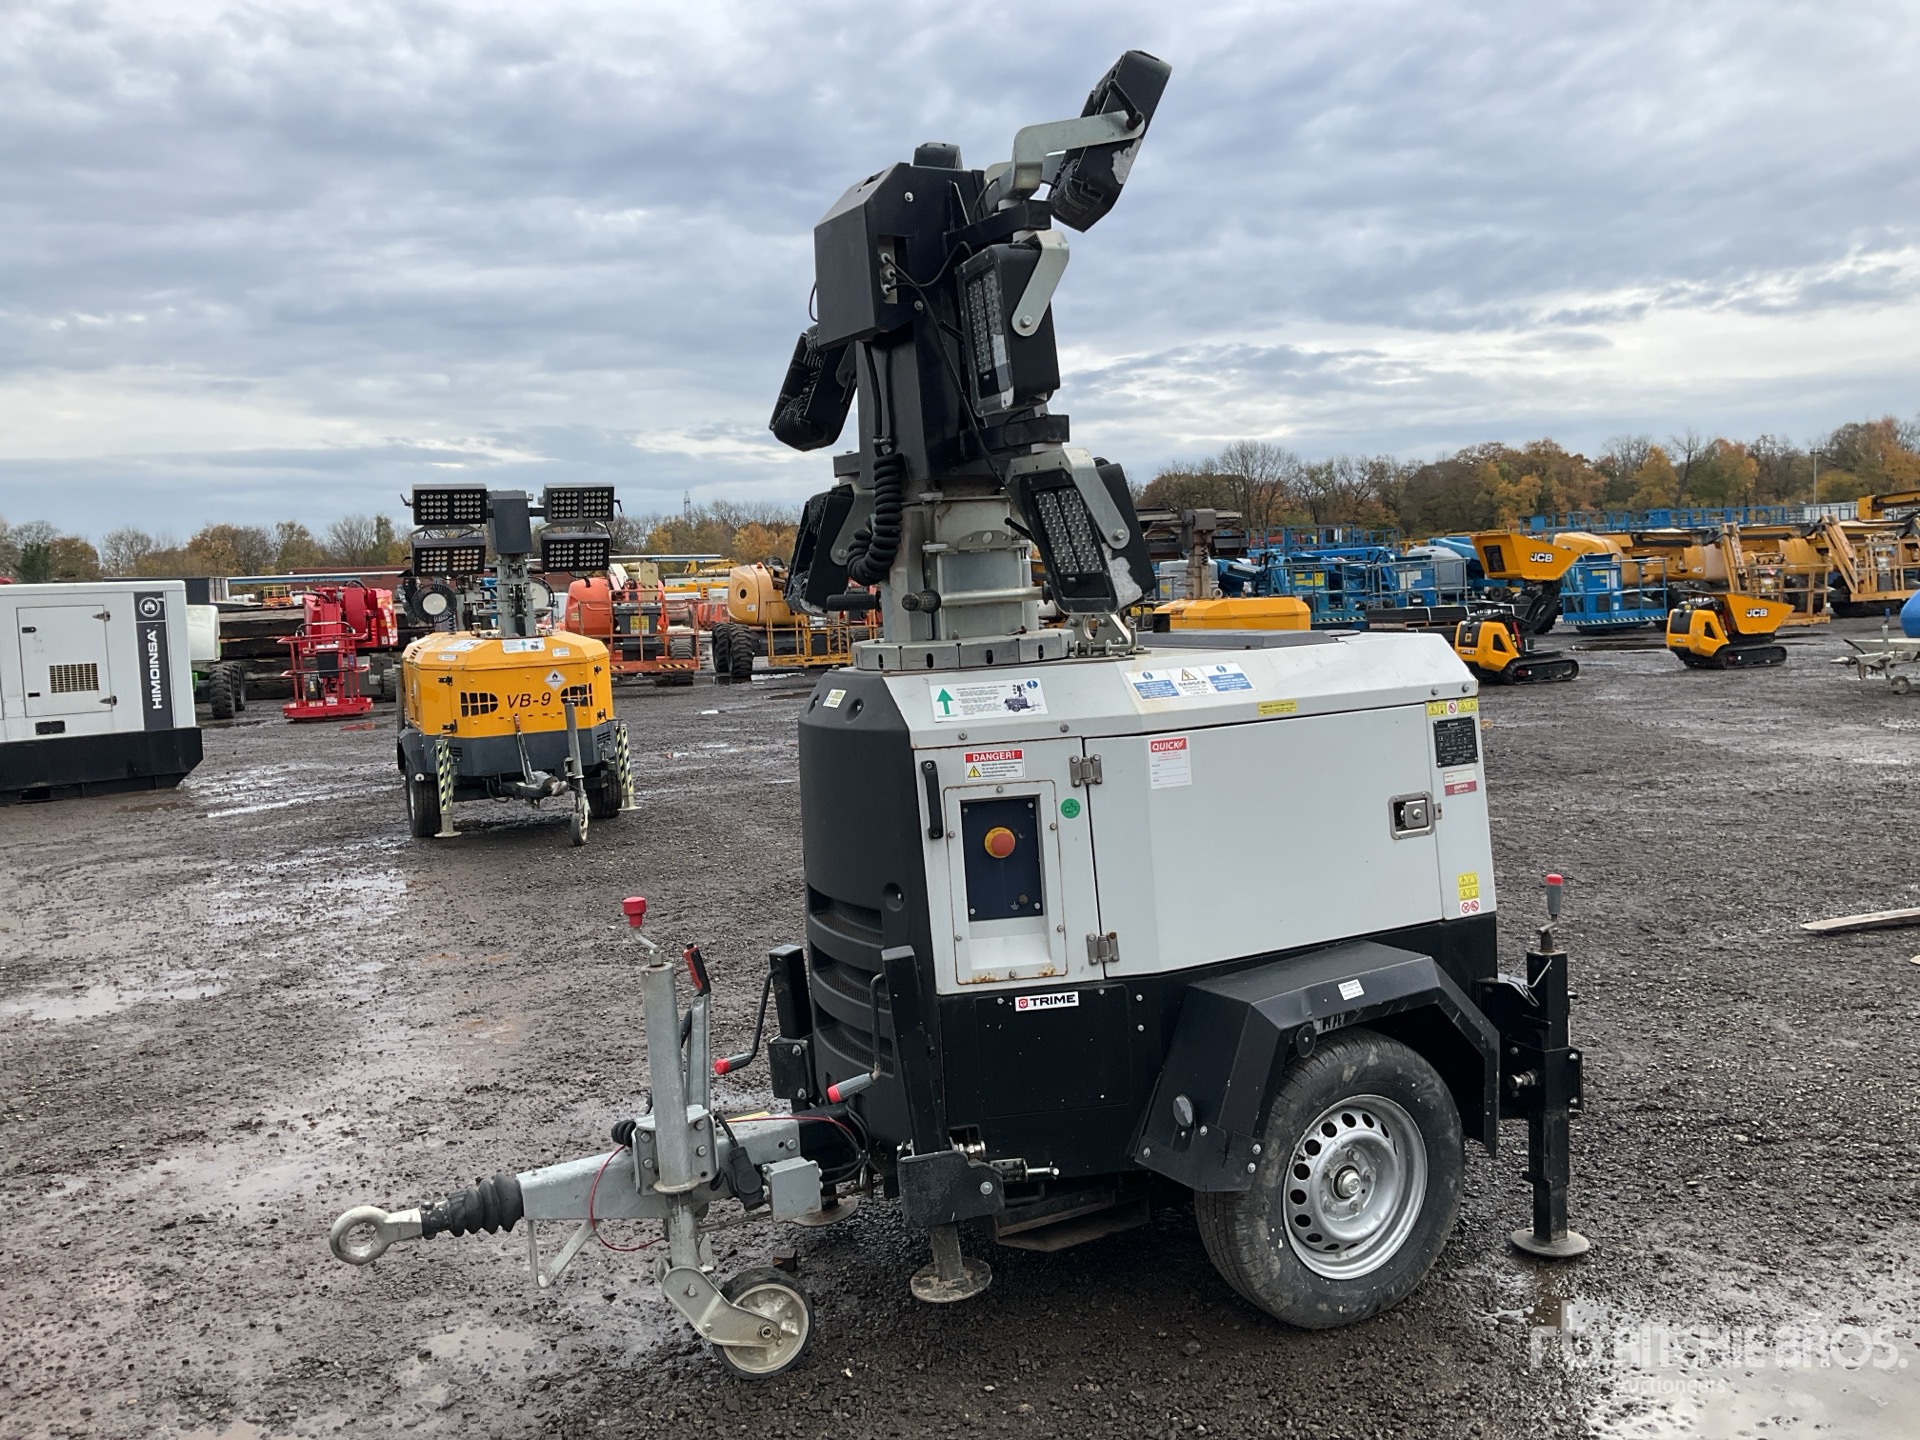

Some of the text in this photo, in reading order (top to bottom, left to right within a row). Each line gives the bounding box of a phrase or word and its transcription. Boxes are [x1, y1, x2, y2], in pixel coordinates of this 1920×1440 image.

[1530, 552, 1553, 563] JCB
[1746, 608, 1768, 618] JCB
[147, 629, 162, 709] HIMOINSA
[507, 692, 552, 708] VB-9
[1152, 740, 1180, 751] QUICK
[972, 751, 1015, 762] DANGER!
[1030, 994, 1076, 1006] TRIME
